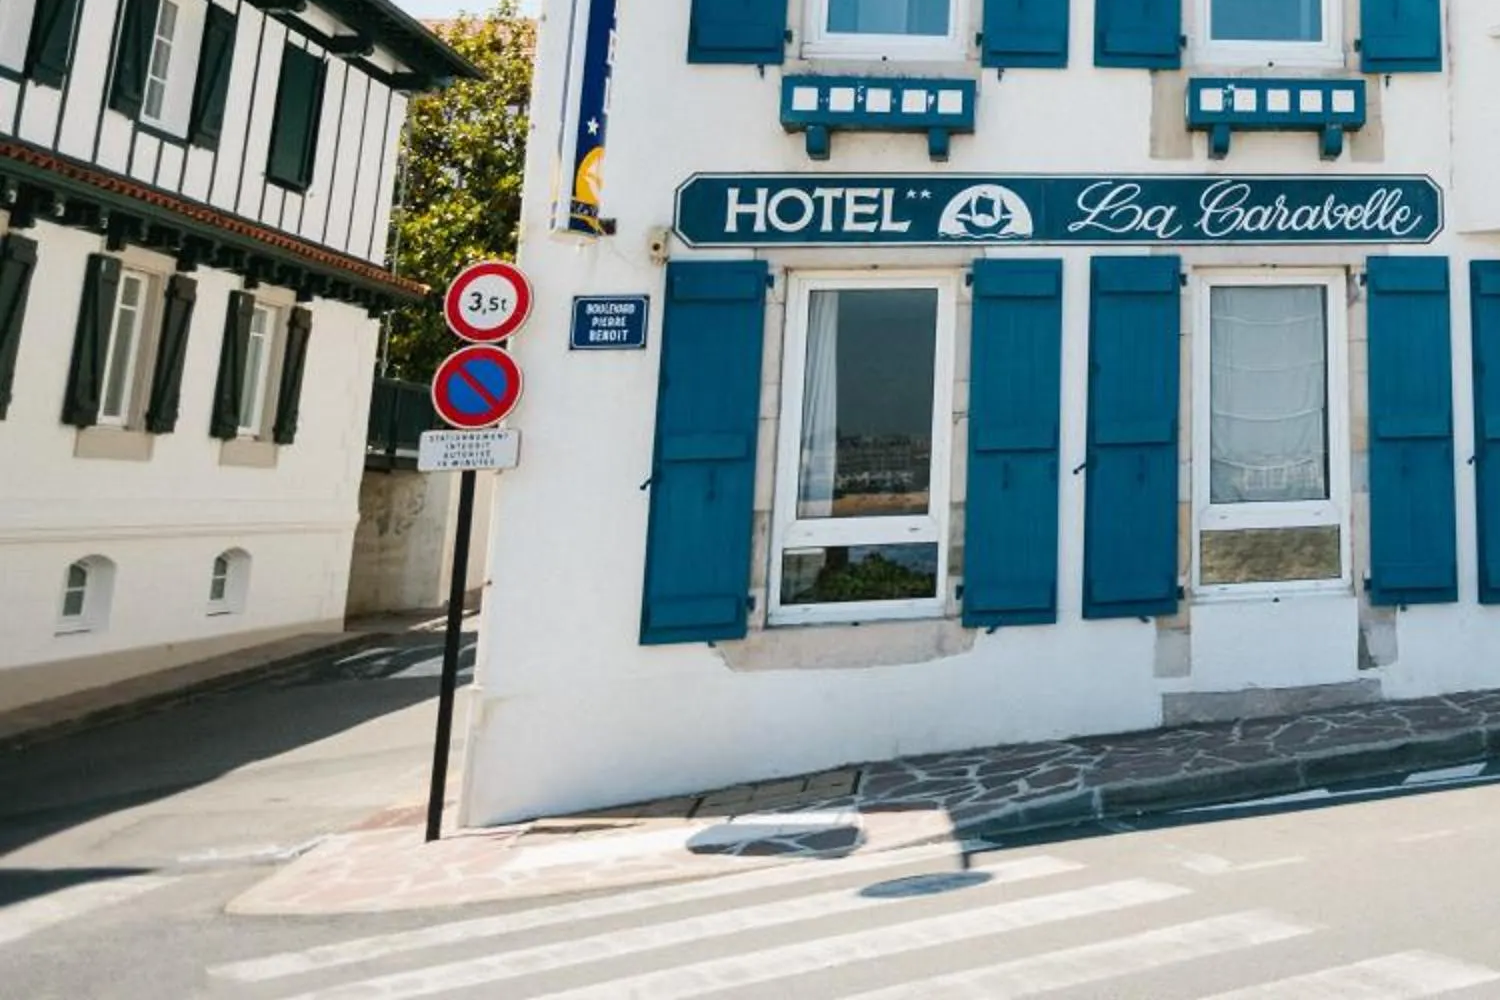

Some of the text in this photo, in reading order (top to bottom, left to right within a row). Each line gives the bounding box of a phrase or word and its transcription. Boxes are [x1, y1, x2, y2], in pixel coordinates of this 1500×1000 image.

[724, 179, 1423, 239] HOTEL La Caravelle
[468, 291, 507, 316] 3,5t
[585, 303, 635, 315] BOULEVARD
[592, 316, 626, 328] PIERRE
[589, 329, 629, 342] BENOIT
